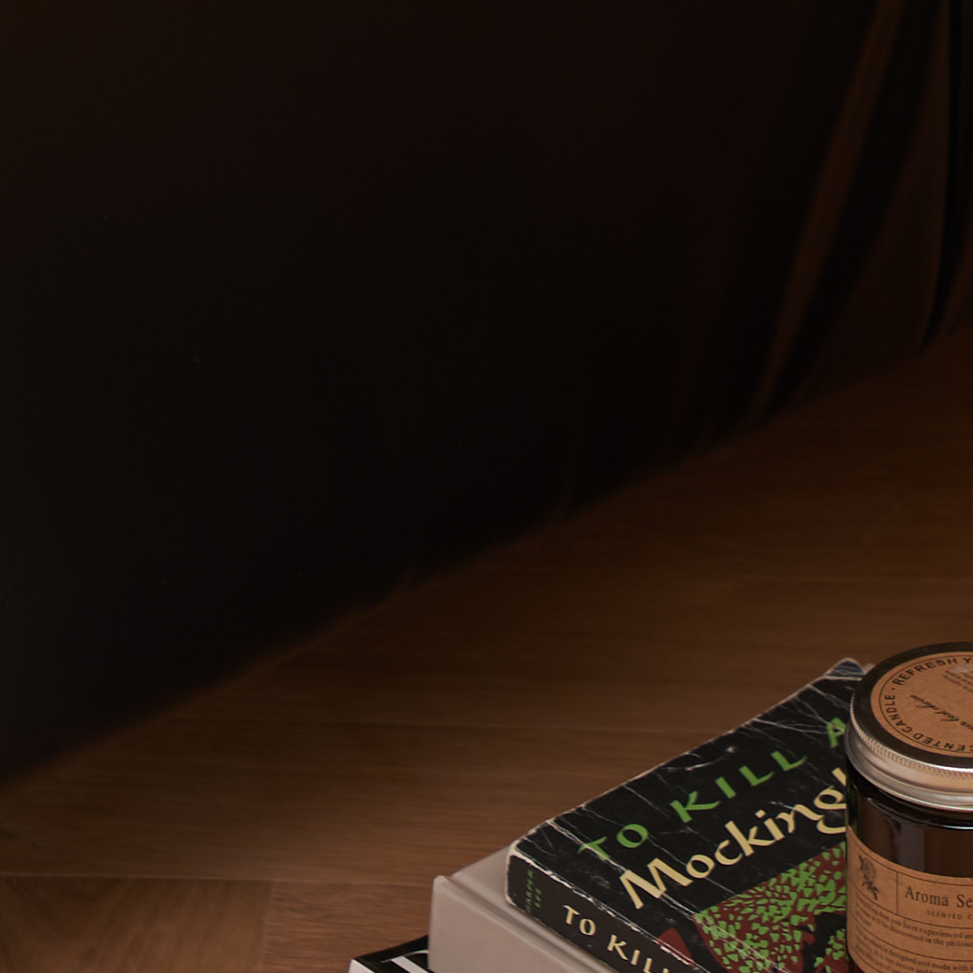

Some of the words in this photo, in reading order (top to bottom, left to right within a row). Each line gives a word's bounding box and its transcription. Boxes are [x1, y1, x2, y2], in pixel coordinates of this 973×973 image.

[893, 657, 958, 686] REFRESH
[884, 694, 914, 735] CANDLE
[577, 823, 649, 862] TO
[669, 750, 806, 823] KILL
[826, 717, 847, 748] A
[619, 767, 847, 909] Mocking
[905, 886, 949, 907] Aroma
[562, 904, 597, 938] TO
[926, 910, 963, 920] SCENTED
[920, 929, 963, 940] experienced
